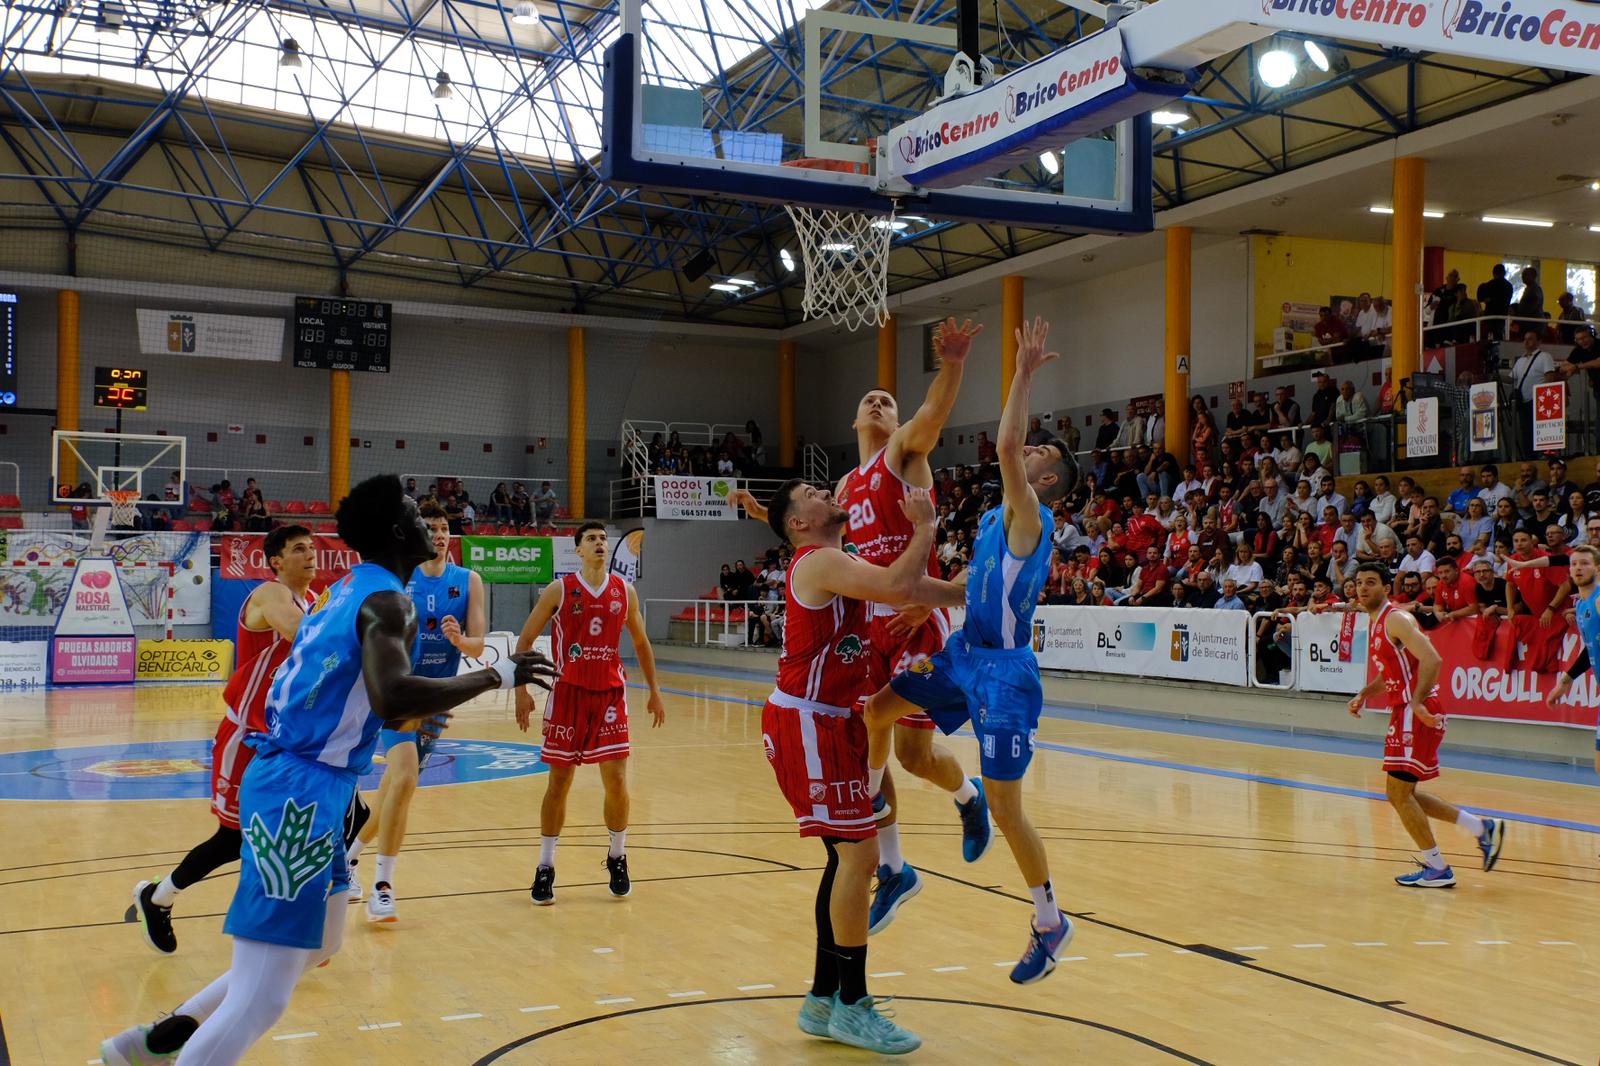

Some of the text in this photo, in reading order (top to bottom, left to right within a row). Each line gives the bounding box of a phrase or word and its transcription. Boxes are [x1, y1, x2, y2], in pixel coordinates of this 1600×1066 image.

[1015, 56, 1120, 118] BricoCentro
[914, 111, 999, 158] BricoCentro
[299, 317, 325, 326] LOCAL
[1177, 356, 1189, 371] A
[661, 480, 702, 490] padel
[681, 509, 695, 517] 664
[708, 510, 722, 518] 489
[848, 497, 876, 531] 20
[250, 549, 352, 571] GLITAT
[495, 547, 542, 562] BASF
[482, 565, 508, 573] create
[508, 564, 542, 574] chemistry
[76, 591, 111, 605] ROSA
[427, 594, 436, 612] 8
[589, 616, 602, 636] 6
[58, 641, 132, 654] PRUEBA SABORES
[1191, 645, 1203, 657] de
[71, 655, 118, 667] OLVIDADOS
[1451, 666, 1543, 703] ORGULL
[604, 705, 618, 724] 6
[1011, 734, 1021, 758] 6
